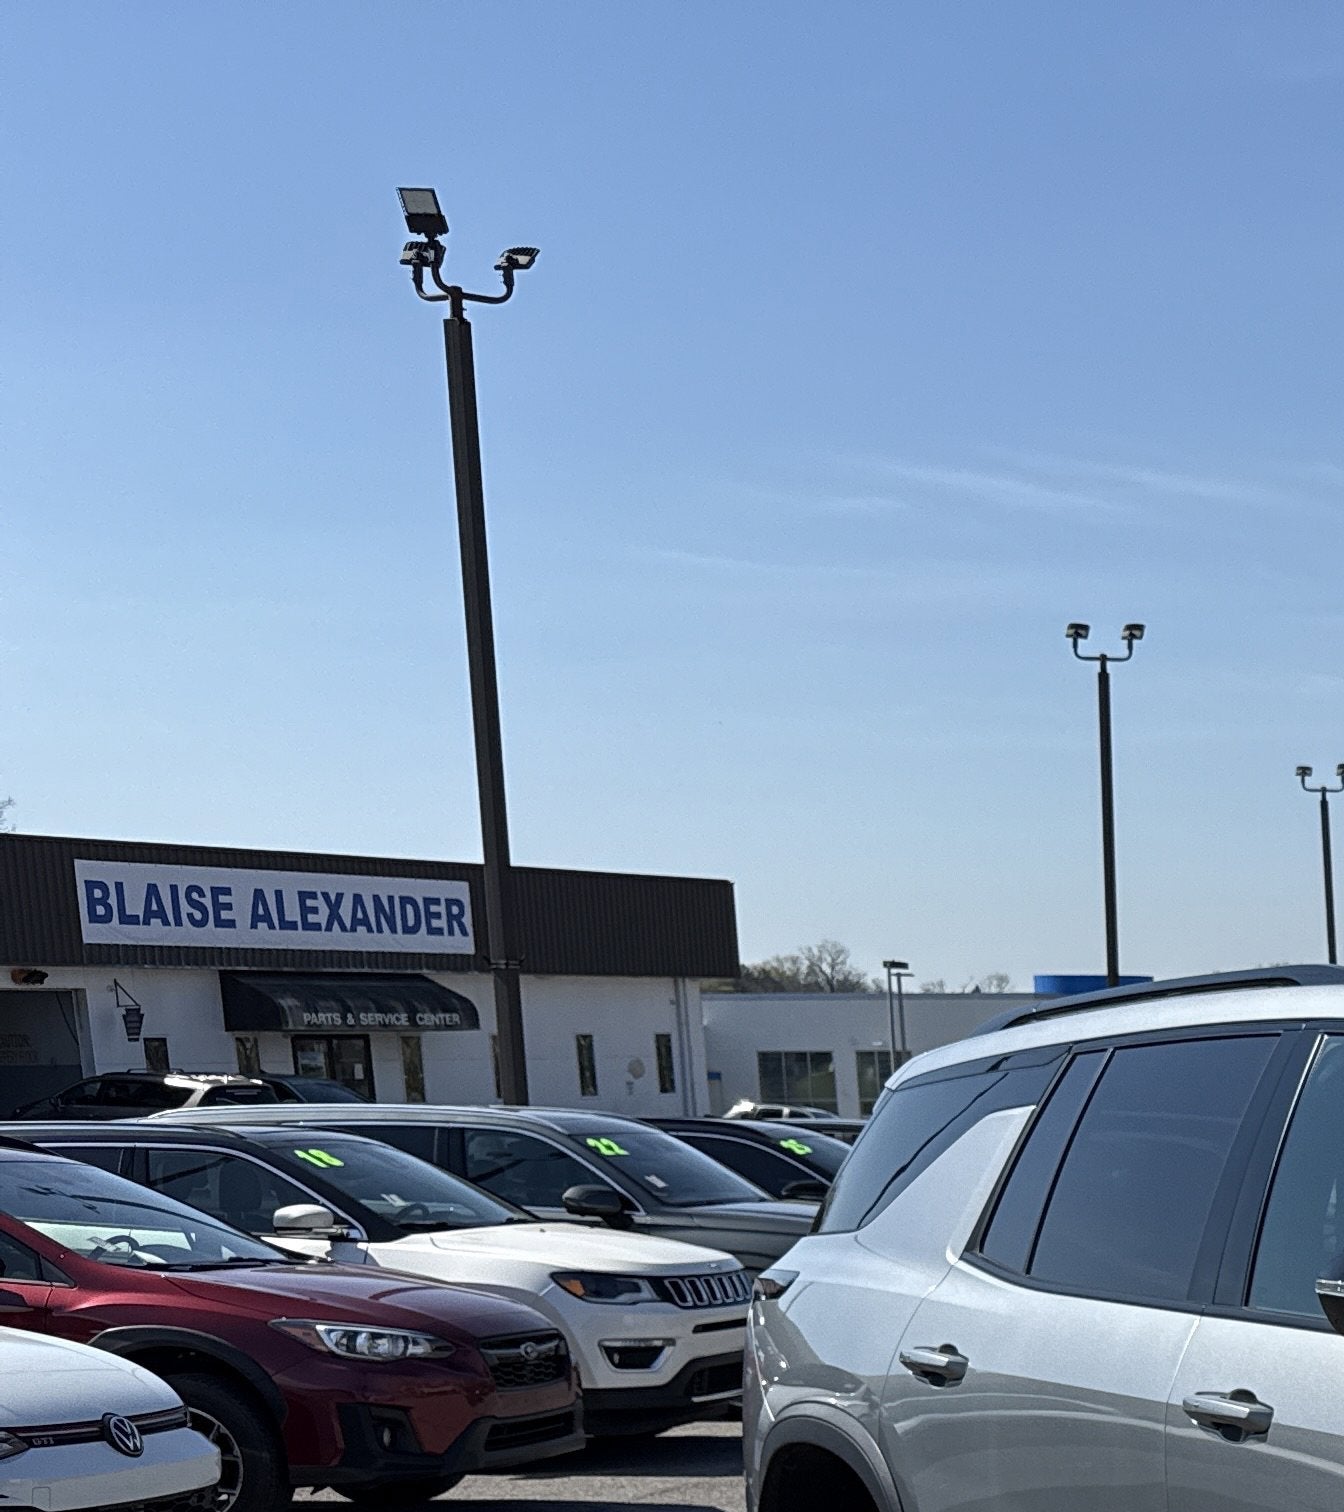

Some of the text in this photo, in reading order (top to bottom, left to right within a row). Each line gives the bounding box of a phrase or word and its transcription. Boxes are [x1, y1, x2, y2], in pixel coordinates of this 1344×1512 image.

[84, 879, 471, 938] BLAISE ALEXANDER
[303, 1012, 462, 1026] PARTS & SERVICE CENTER
[585, 1137, 630, 1156] 22
[293, 1148, 345, 1169] 18
[31, 1437, 55, 1446] GTI
